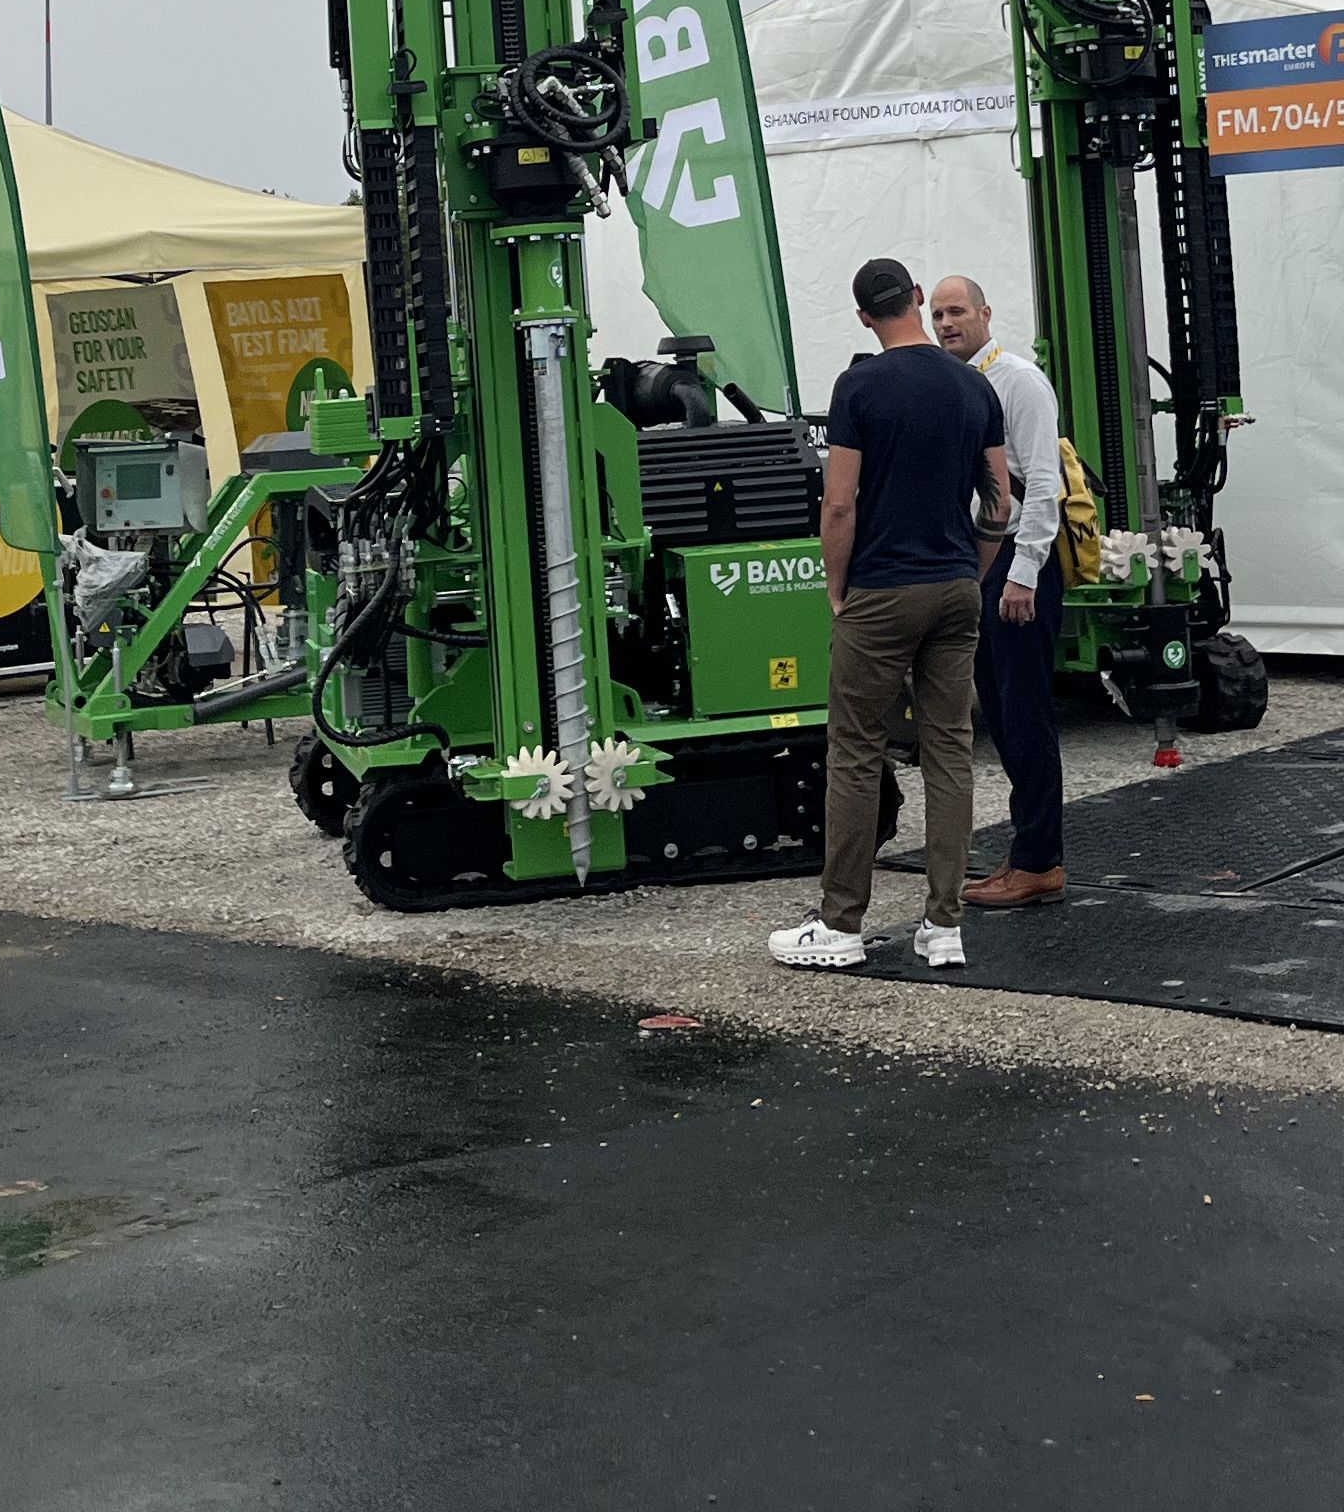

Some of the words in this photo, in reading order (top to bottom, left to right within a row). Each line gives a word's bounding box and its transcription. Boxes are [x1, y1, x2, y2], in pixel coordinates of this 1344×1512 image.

[1212, 53, 1237, 68] THE
[1238, 42, 1316, 66] smarter
[764, 109, 830, 128] SHANGHAI
[832, 104, 881, 122] FOUND
[883, 97, 974, 117] AUTOMATION
[976, 94, 1016, 110] EQUIP
[69, 306, 138, 335] GEOSCAN
[73, 338, 105, 364] FOR
[106, 336, 148, 362] YOUR
[230, 331, 275, 357] TEST
[278, 327, 330, 355] FRAME
[76, 367, 136, 393] SAFETY
[749, 584, 785, 595] SCREWS
[787, 583, 795, 592] &
